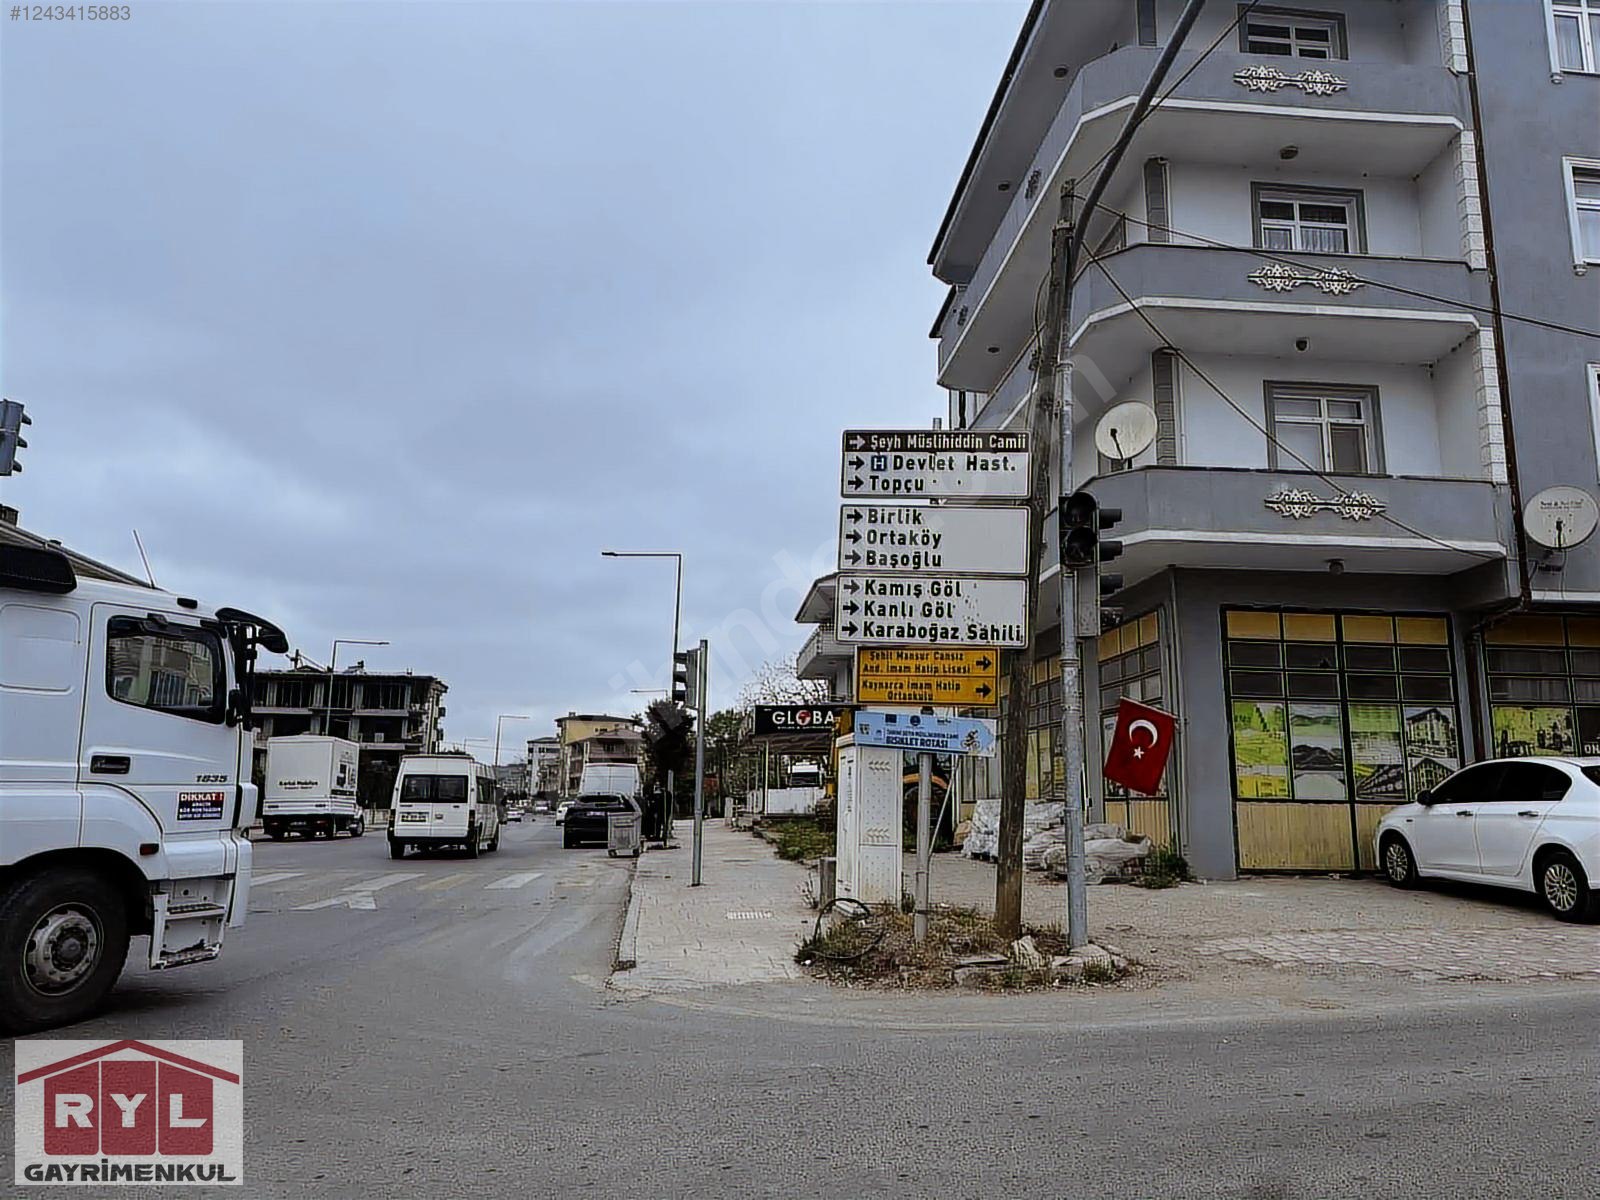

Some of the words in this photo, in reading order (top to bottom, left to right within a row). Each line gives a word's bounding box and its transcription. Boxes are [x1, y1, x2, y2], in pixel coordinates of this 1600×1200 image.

[870, 435, 900, 451] Şeyh
[907, 434, 983, 449] Müslihiddin
[989, 435, 1026, 449] Camii
[893, 456, 955, 471] Devlet
[966, 455, 1016, 472] Hast.
[869, 476, 925, 494] Topçu
[867, 508, 922, 525] Birlik
[866, 529, 942, 549] Ortaköy
[865, 550, 942, 569] Başoğlu
[864, 579, 923, 598] Kamış
[930, 580, 962, 597] Göl
[864, 601, 913, 618] Kanlı
[922, 601, 953, 618] Göl
[863, 621, 960, 642] Karaboğaz
[967, 623, 1021, 641] Sahili
[772, 709, 834, 725] GLOBA
